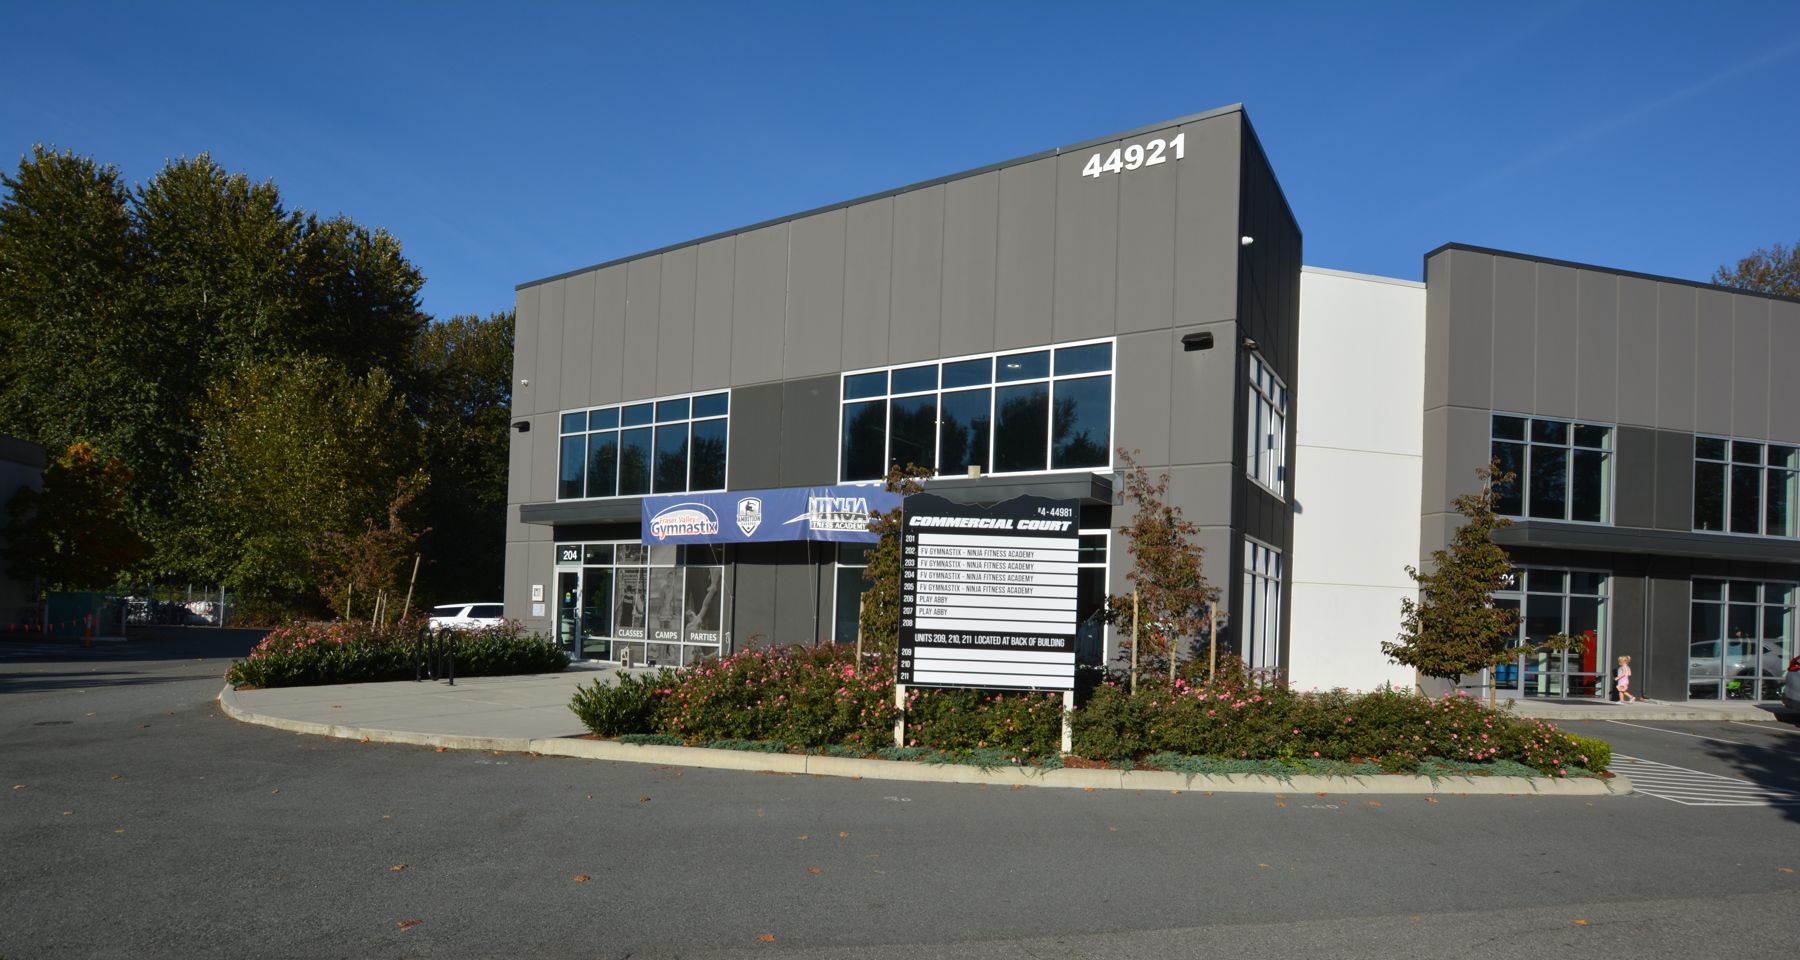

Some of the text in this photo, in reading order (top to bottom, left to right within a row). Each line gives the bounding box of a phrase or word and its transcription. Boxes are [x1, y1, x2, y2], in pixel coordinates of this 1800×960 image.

[1082, 132, 1185, 178] 44921
[679, 515, 696, 525] Valley
[909, 516, 1072, 531] COMMERCIAL COURT
[652, 520, 718, 540] Gymnastix
[835, 522, 866, 530] ACADEMY
[905, 535, 915, 543] 201
[563, 550, 578, 560] 204
[904, 547, 915, 555] 202
[920, 547, 928, 555] FV
[929, 547, 961, 556] GYMNASTIX
[984, 549, 1006, 557] FITNESS
[1008, 550, 1034, 558] ACADEMY
[904, 559, 915, 567] 203
[920, 559, 928, 567] FV
[929, 559, 960, 568] GYMNASTIX
[983, 561, 1006, 570] FITNESS
[1007, 562, 1034, 570] ACADEMY
[928, 571, 960, 580] GYMNASTIX
[983, 573, 1006, 582] FITNESS
[1007, 574, 1033, 582] ACADEMY
[903, 583, 914, 591] 205
[928, 583, 960, 592] GYMNASTIX
[1006, 586, 1033, 594] ACADEMY
[903, 595, 948, 604] 206 PLAY ABBY
[903, 607, 948, 616] 207 PLAY ABBY
[618, 629, 644, 638] CLASSES
[655, 631, 678, 639] CAMPS
[690, 632, 717, 641] PARTIES
[915, 633, 1065, 647] UNITS 209, 210, 211 LOCATED AT BACK OF BUILDING
[901, 648, 912, 656] 209
[900, 660, 911, 668] 210
[900, 672, 909, 680] 211
